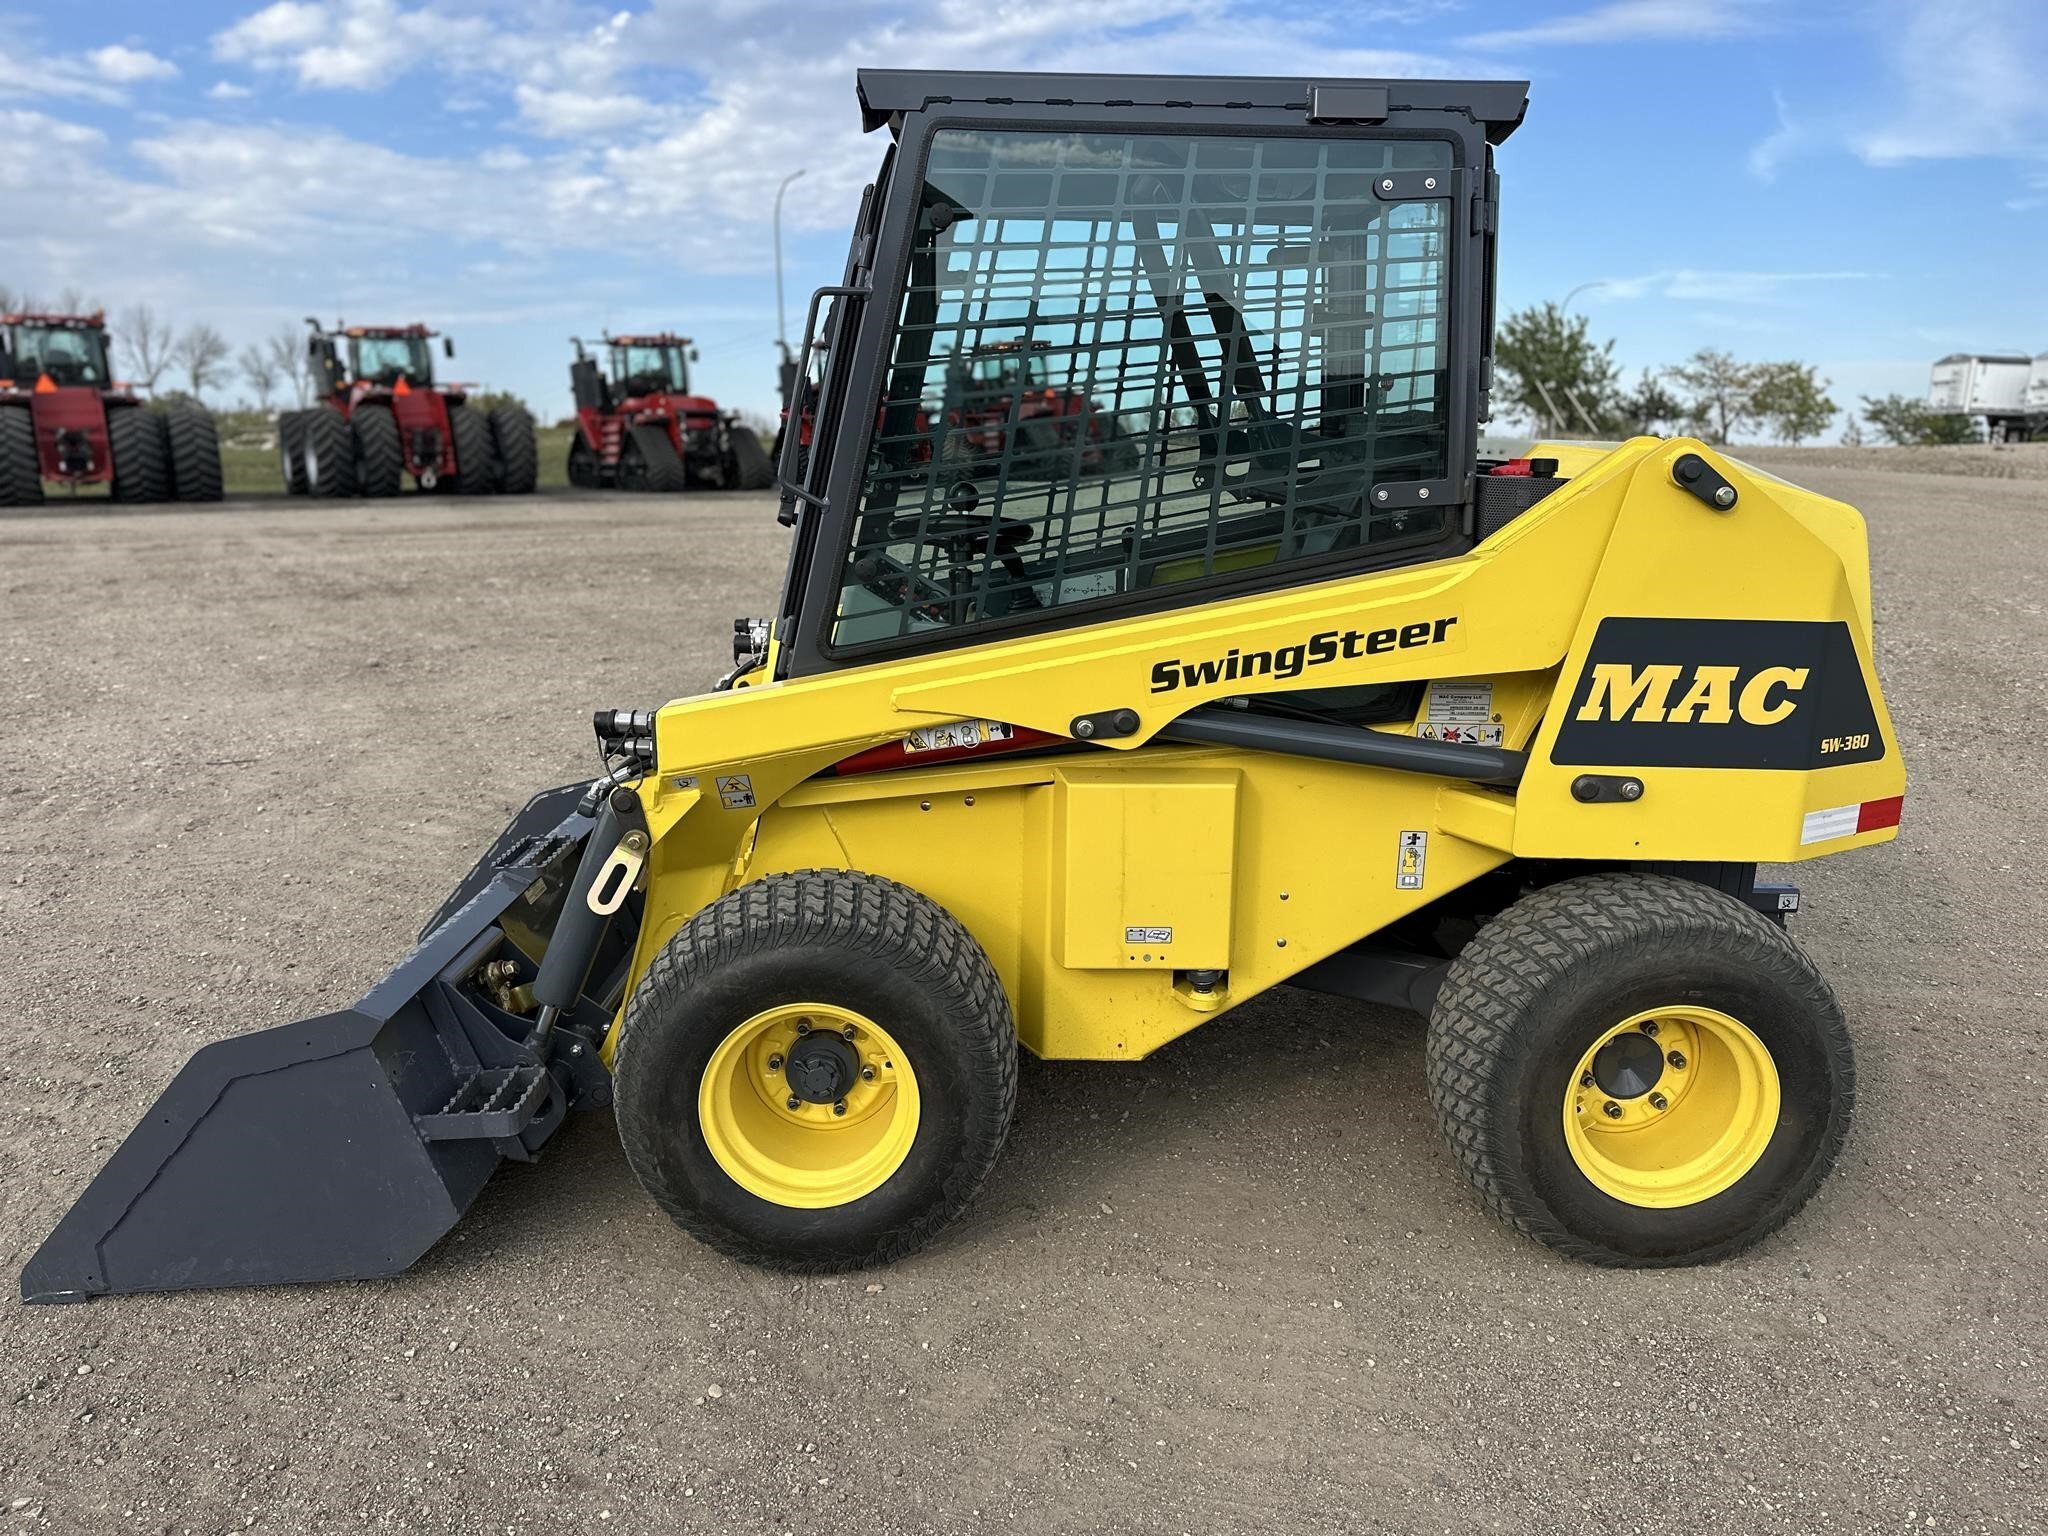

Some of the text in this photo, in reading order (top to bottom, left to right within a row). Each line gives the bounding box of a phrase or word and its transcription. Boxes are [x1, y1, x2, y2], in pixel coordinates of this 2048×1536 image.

[1150, 617, 1458, 694] SwingSteer
[1575, 663, 1810, 726] MAC
[1820, 733, 1870, 754] SW-380
